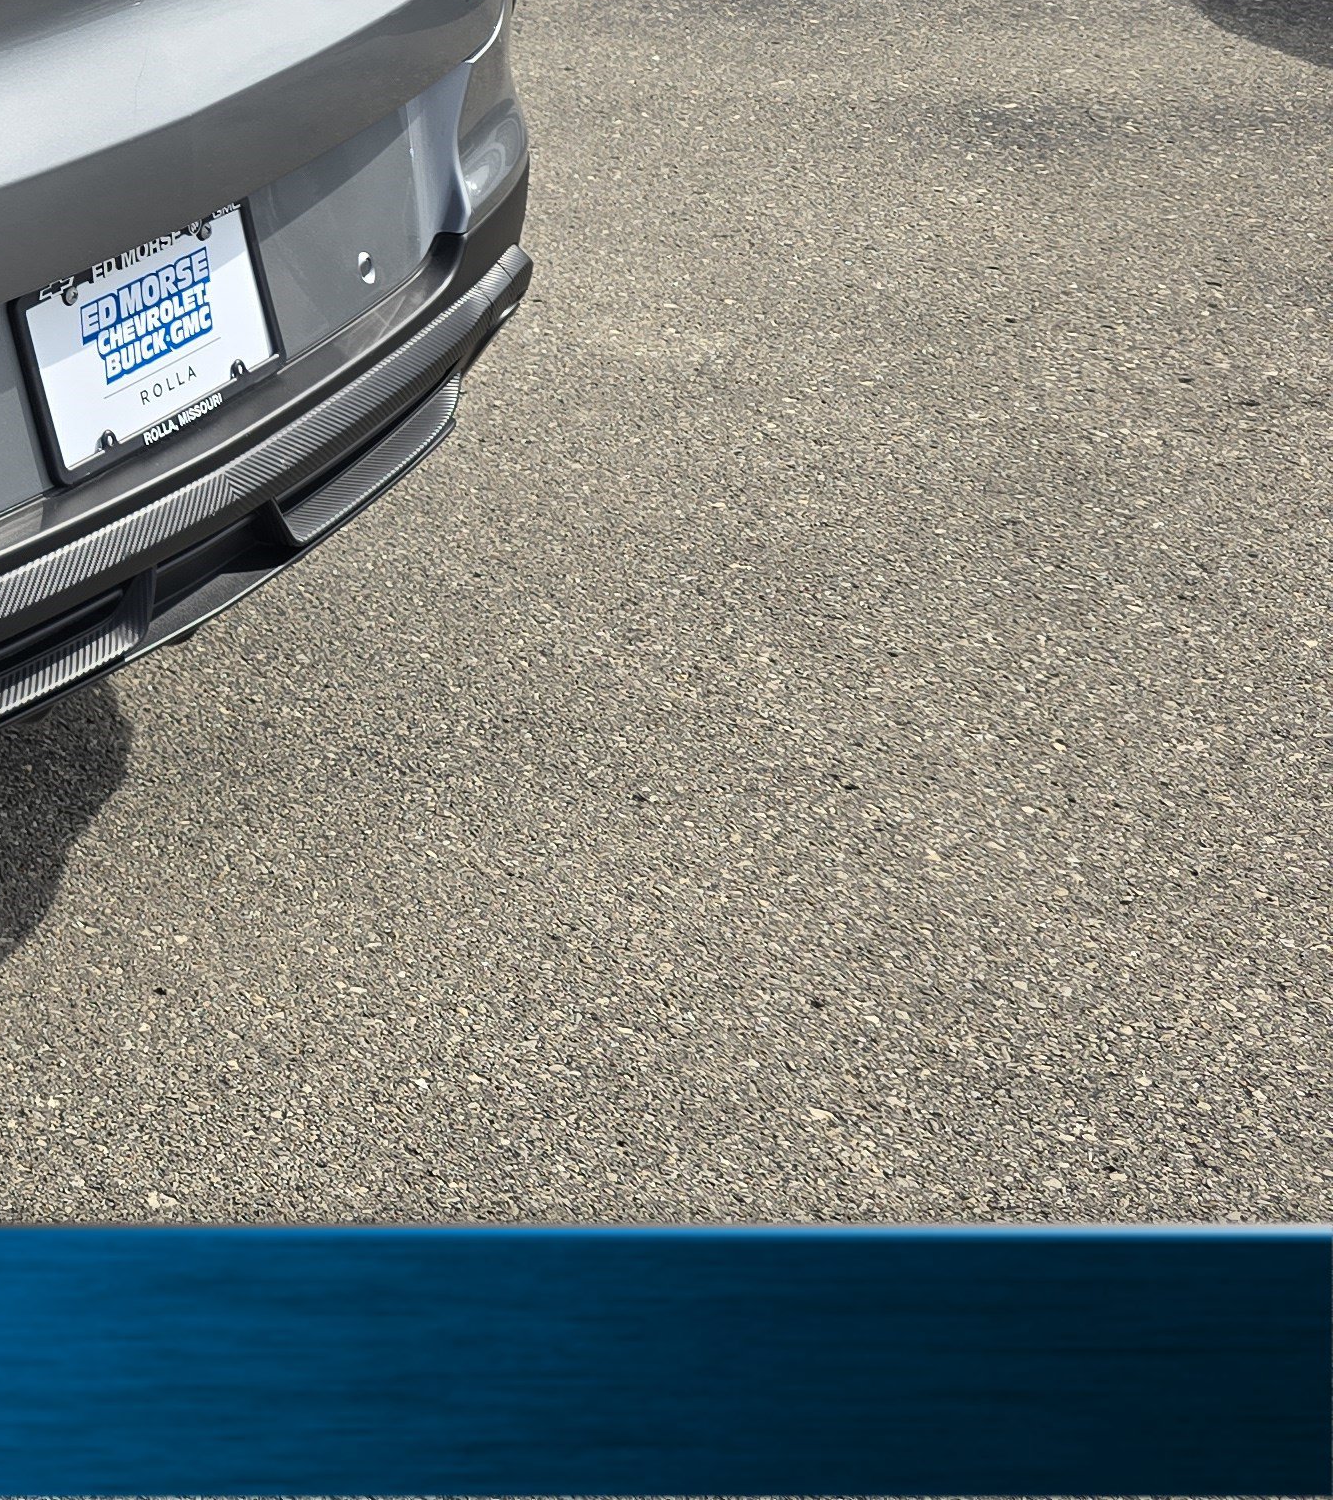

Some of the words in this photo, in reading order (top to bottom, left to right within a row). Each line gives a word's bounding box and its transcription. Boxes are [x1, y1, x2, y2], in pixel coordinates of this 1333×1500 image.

[81, 296, 117, 338] ED
[118, 248, 210, 316] MORSE
[91, 257, 118, 284] ED
[96, 287, 207, 353] CHEVROLET
[139, 365, 198, 405] ROLLA
[143, 420, 180, 447] ROLLA,
[178, 392, 223, 427] MISSOURI
